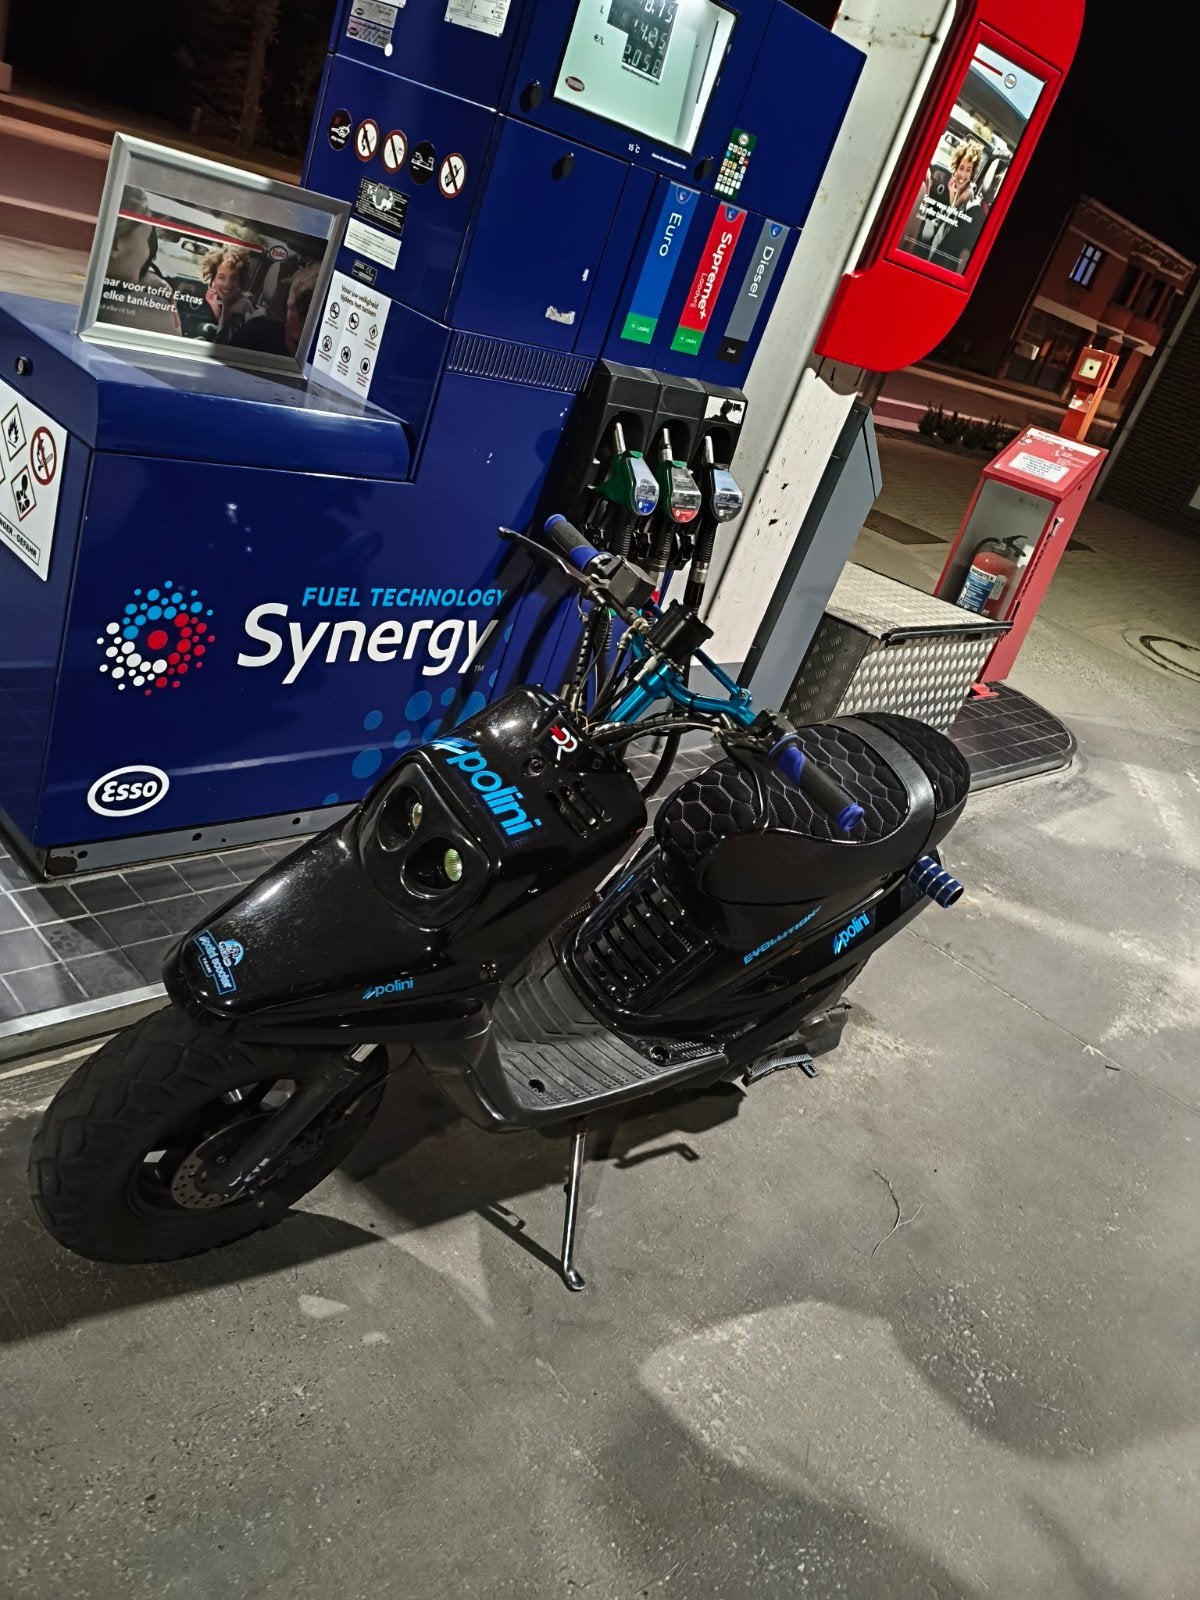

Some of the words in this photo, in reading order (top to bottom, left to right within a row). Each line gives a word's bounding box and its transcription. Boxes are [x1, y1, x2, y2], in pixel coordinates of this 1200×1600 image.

[659, 212, 683, 257] Euro
[698, 231, 733, 320] Supreme+
[748, 245, 774, 298] Diesel
[102, 290, 125, 302] elke
[127, 294, 178, 313] tankbeurt.
[122, 281, 145, 292] voor
[147, 286, 172, 299] toffe
[173, 290, 203, 306] Extras
[16, 533, 37, 559] GEFAHR
[302, 587, 361, 607] FUEL
[370, 588, 507, 608] TECHNOLOGY
[237, 602, 499, 685] Synergy
[101, 780, 158, 803] Esso
[446, 750, 542, 836] polini
[839, 910, 870, 948] polini
[374, 977, 414, 998] polini
